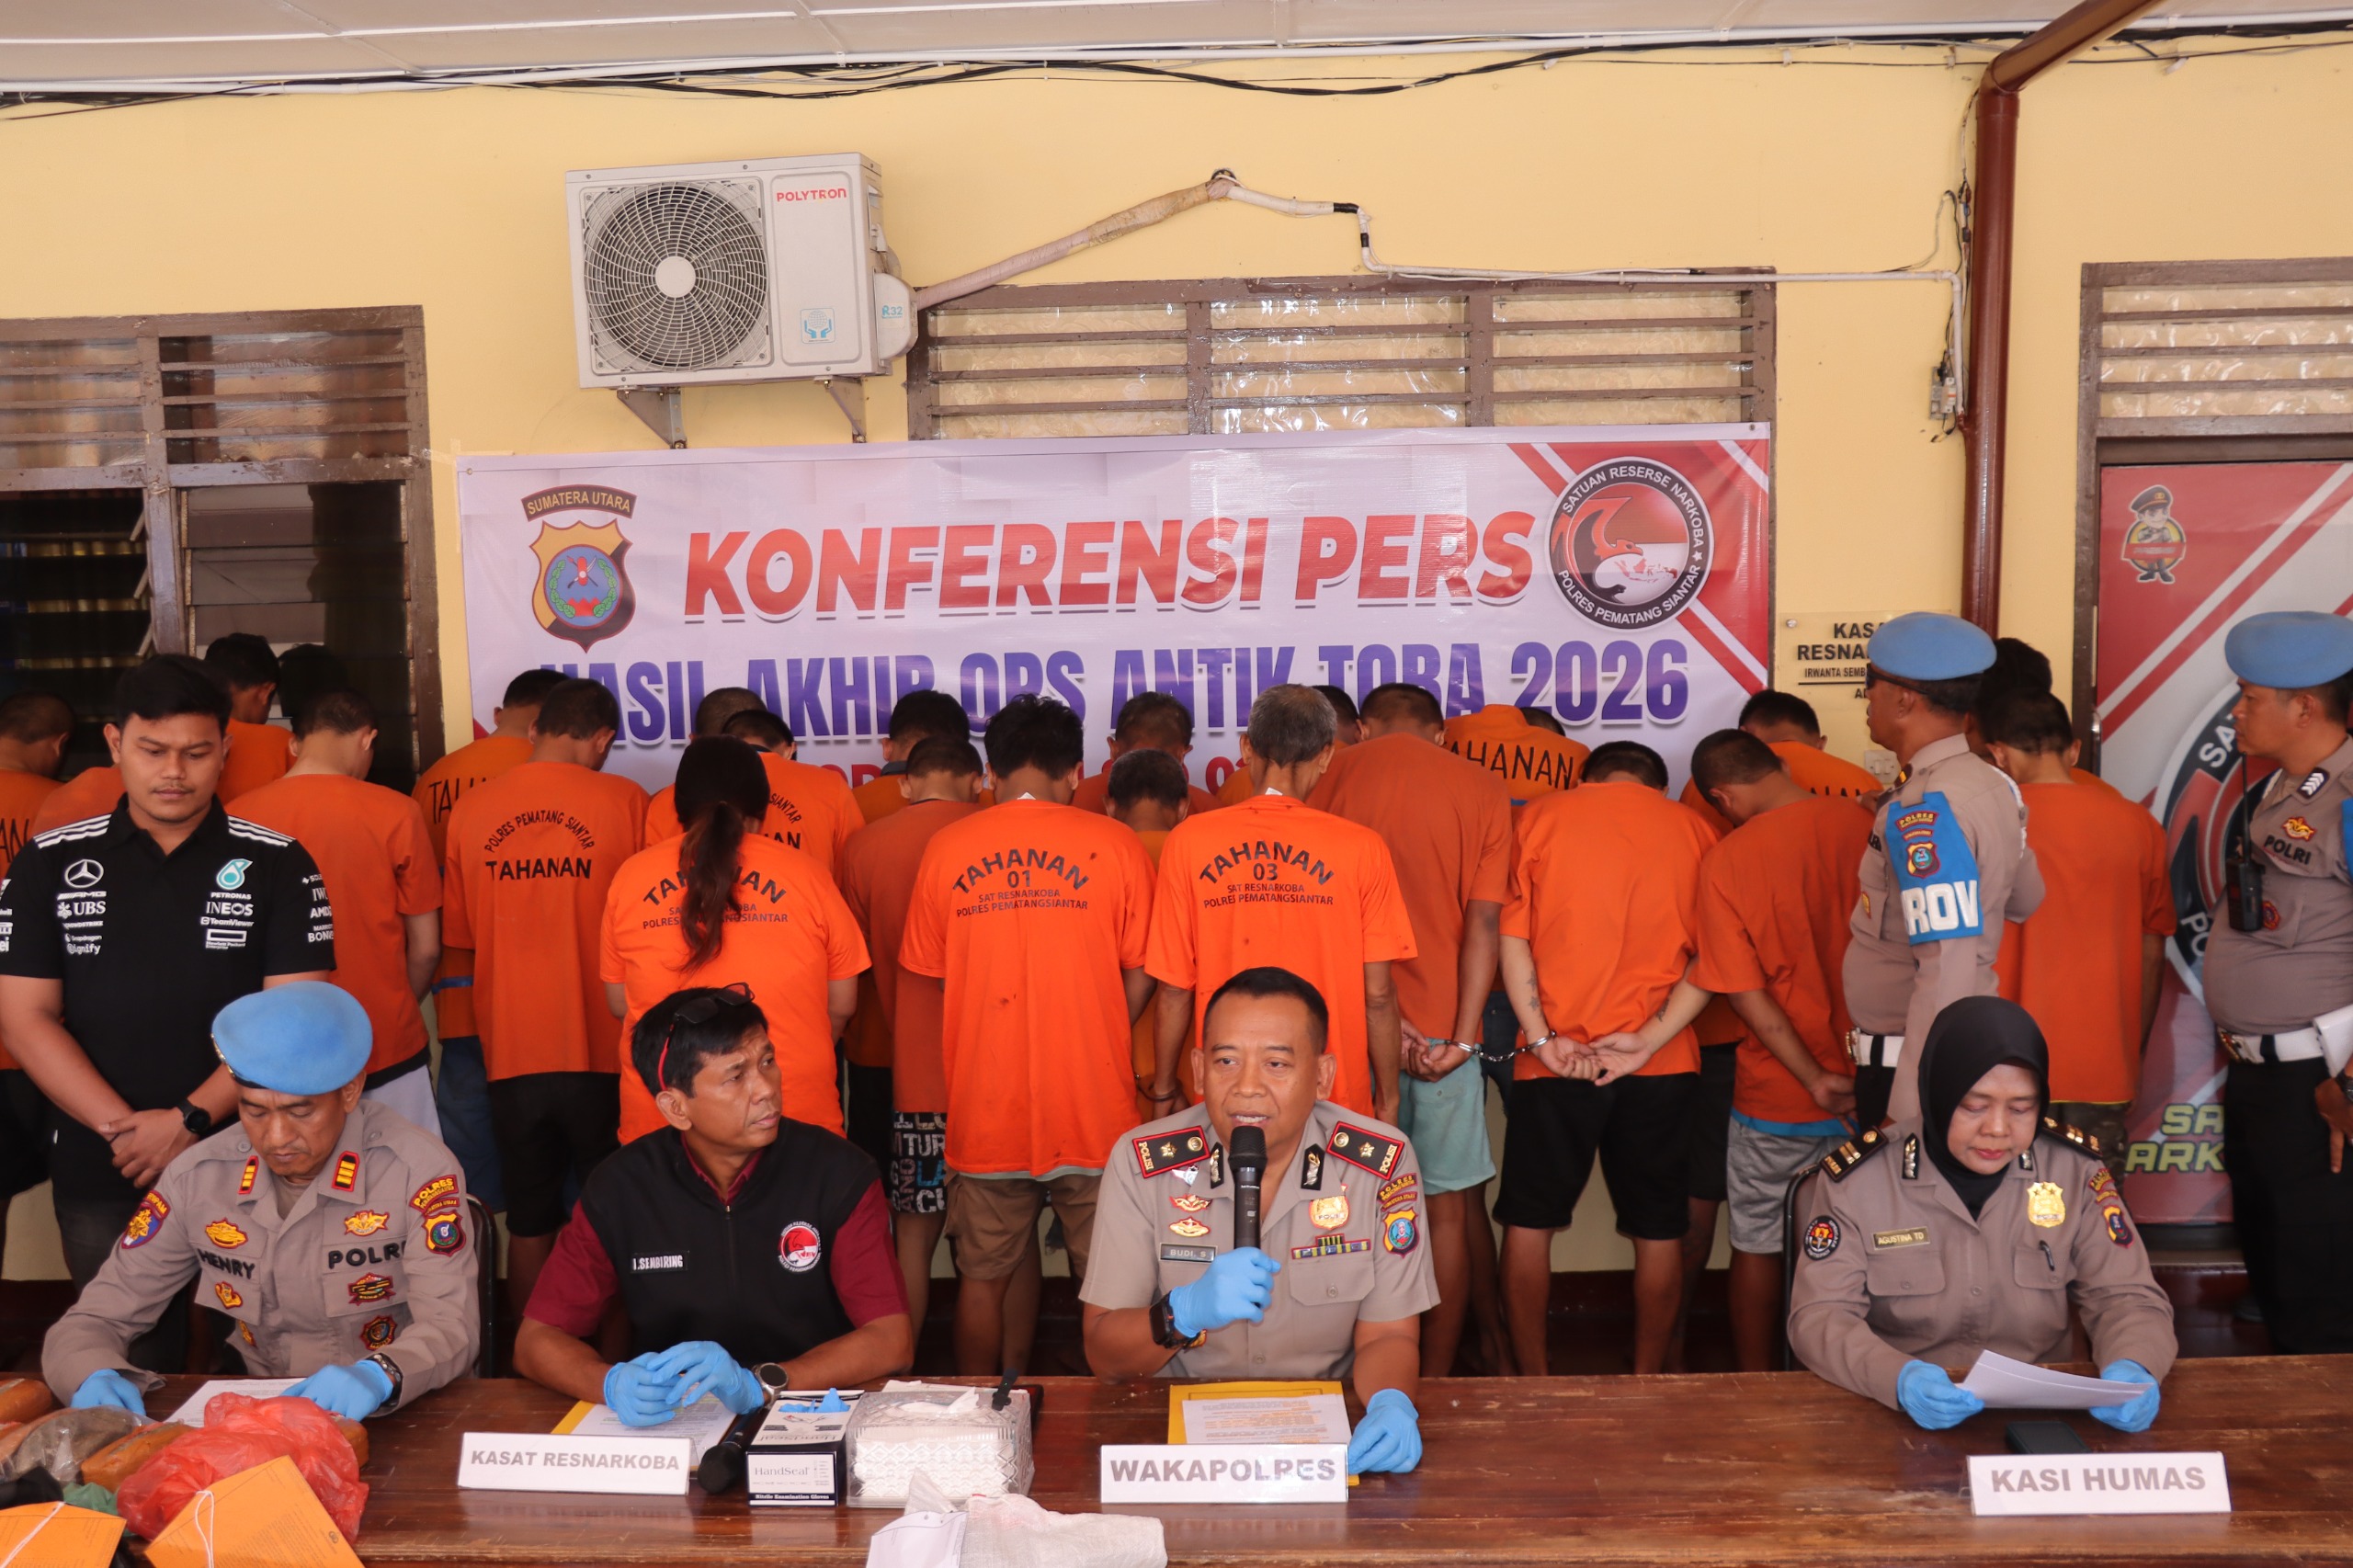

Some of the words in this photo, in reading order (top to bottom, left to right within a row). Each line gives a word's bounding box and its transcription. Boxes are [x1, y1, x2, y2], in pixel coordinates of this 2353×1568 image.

[777, 187, 847, 202] POLYTRON
[881, 304, 904, 316] R32
[527, 491, 589, 516] SUMATERA
[592, 492, 631, 513] UTARA
[1563, 471, 1608, 514] SATUAN
[1609, 465, 1672, 488] RESERSE
[1671, 483, 1704, 548] NARKOBA
[684, 516, 1270, 618] KONFERENSI
[1295, 511, 1537, 601] PERS
[1558, 569, 1596, 613] POLRES
[1595, 606, 1663, 625] PEMATANG
[1662, 564, 1701, 613] SIANTAR
[1834, 622, 1884, 639] KAS
[1797, 644, 1870, 661] RESNA
[1804, 667, 1841, 678] IRWANTA
[1843, 666, 1867, 677] SEMB
[540, 660, 705, 742] ASIL
[1510, 639, 1689, 722] 2026
[768, 792, 802, 824] SIANTAR
[483, 821, 516, 854] POLRES
[515, 809, 565, 828] PEMATANG
[564, 816, 596, 850] SIANTAR
[2264, 835, 2313, 866] POLRI
[485, 857, 593, 881] TAHANAN
[952, 847, 1090, 894] TAHANAN
[1199, 840, 1335, 886] TAHANAN
[1253, 862, 1279, 881] 03
[642, 865, 788, 906] TAAN
[1006, 869, 1031, 889] 01
[1227, 883, 1242, 893] SAT
[1245, 882, 1305, 892] RESNARKOBA
[210, 892, 252, 900] PETRONAS
[978, 892, 995, 903] SAT
[998, 889, 1061, 900] RESNARKOBA
[1204, 894, 1236, 909] POLRES
[1238, 892, 1334, 905] PEMATANGSIANTAR
[74, 901, 107, 916] UBS
[205, 901, 255, 916] INEOS
[956, 903, 990, 918] POLRES
[992, 899, 1088, 911] PEMATANGSIANTAR
[210, 916, 255, 927] TeamViewer
[1138, 1141, 1154, 1171] POLISI
[1379, 1143, 1398, 1175] POLISI
[414, 1177, 454, 1207] POLRES
[1380, 1175, 1414, 1198] POLRES
[1878, 1233, 1913, 1245] AGUSTINA
[197, 1247, 256, 1279] HENRY
[471, 1449, 538, 1467] KASAT
[542, 1452, 680, 1471] RESNARKOBA
[754, 1466, 809, 1476] HandSeal
[1991, 1468, 2072, 1493] KASI
[2083, 1467, 2207, 1492] HUMAS
